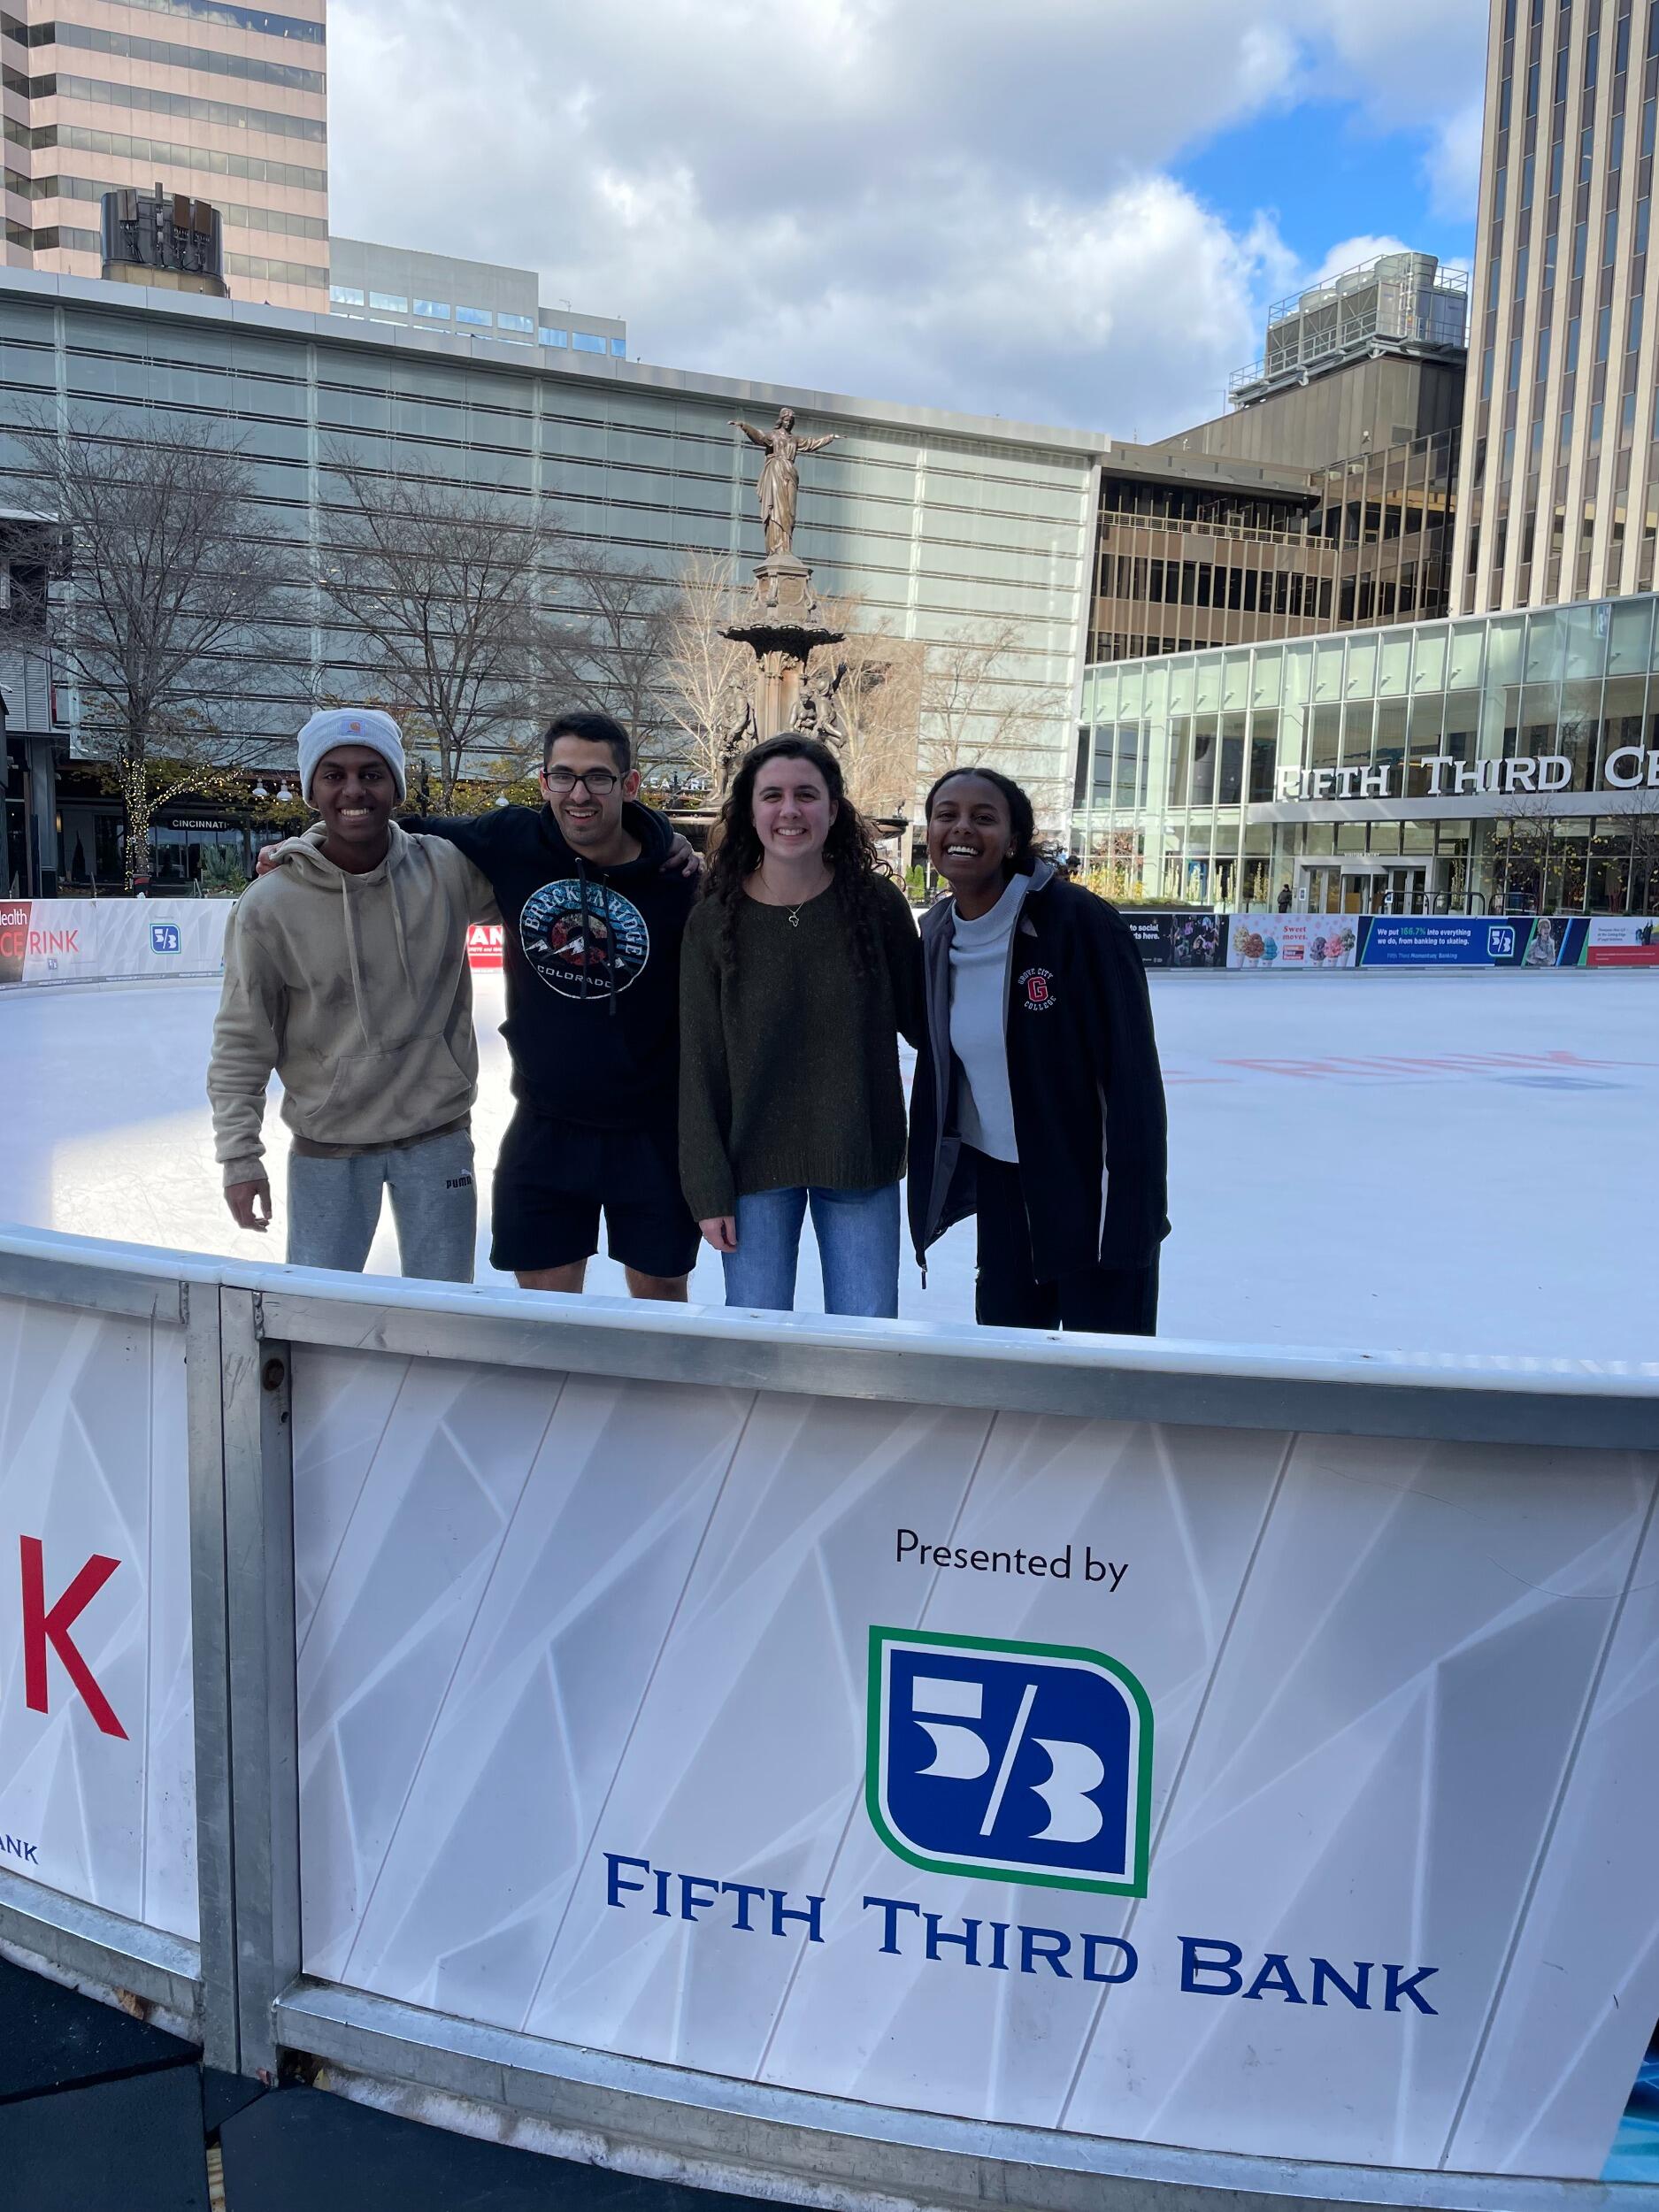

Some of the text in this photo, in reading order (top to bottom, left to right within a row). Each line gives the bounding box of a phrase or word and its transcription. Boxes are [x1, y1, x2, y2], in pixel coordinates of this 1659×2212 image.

[1275, 764, 1392, 803] FIFTH
[1421, 755, 1572, 795] THIRD
[173, 819, 227, 829] CINCINNATI
[29, 929, 79, 955] RINK
[1018, 968, 1054, 985] GROVE CITY
[1028, 976, 1048, 1002] G
[1024, 995, 1056, 1010] COLLEGE
[446, 1175, 472, 1189] PUMA
[896, 1528, 1129, 1593] Presented by
[20, 1534, 130, 1741] K
[603, 1852, 1439, 2016] FIFTH THIRD BANK
